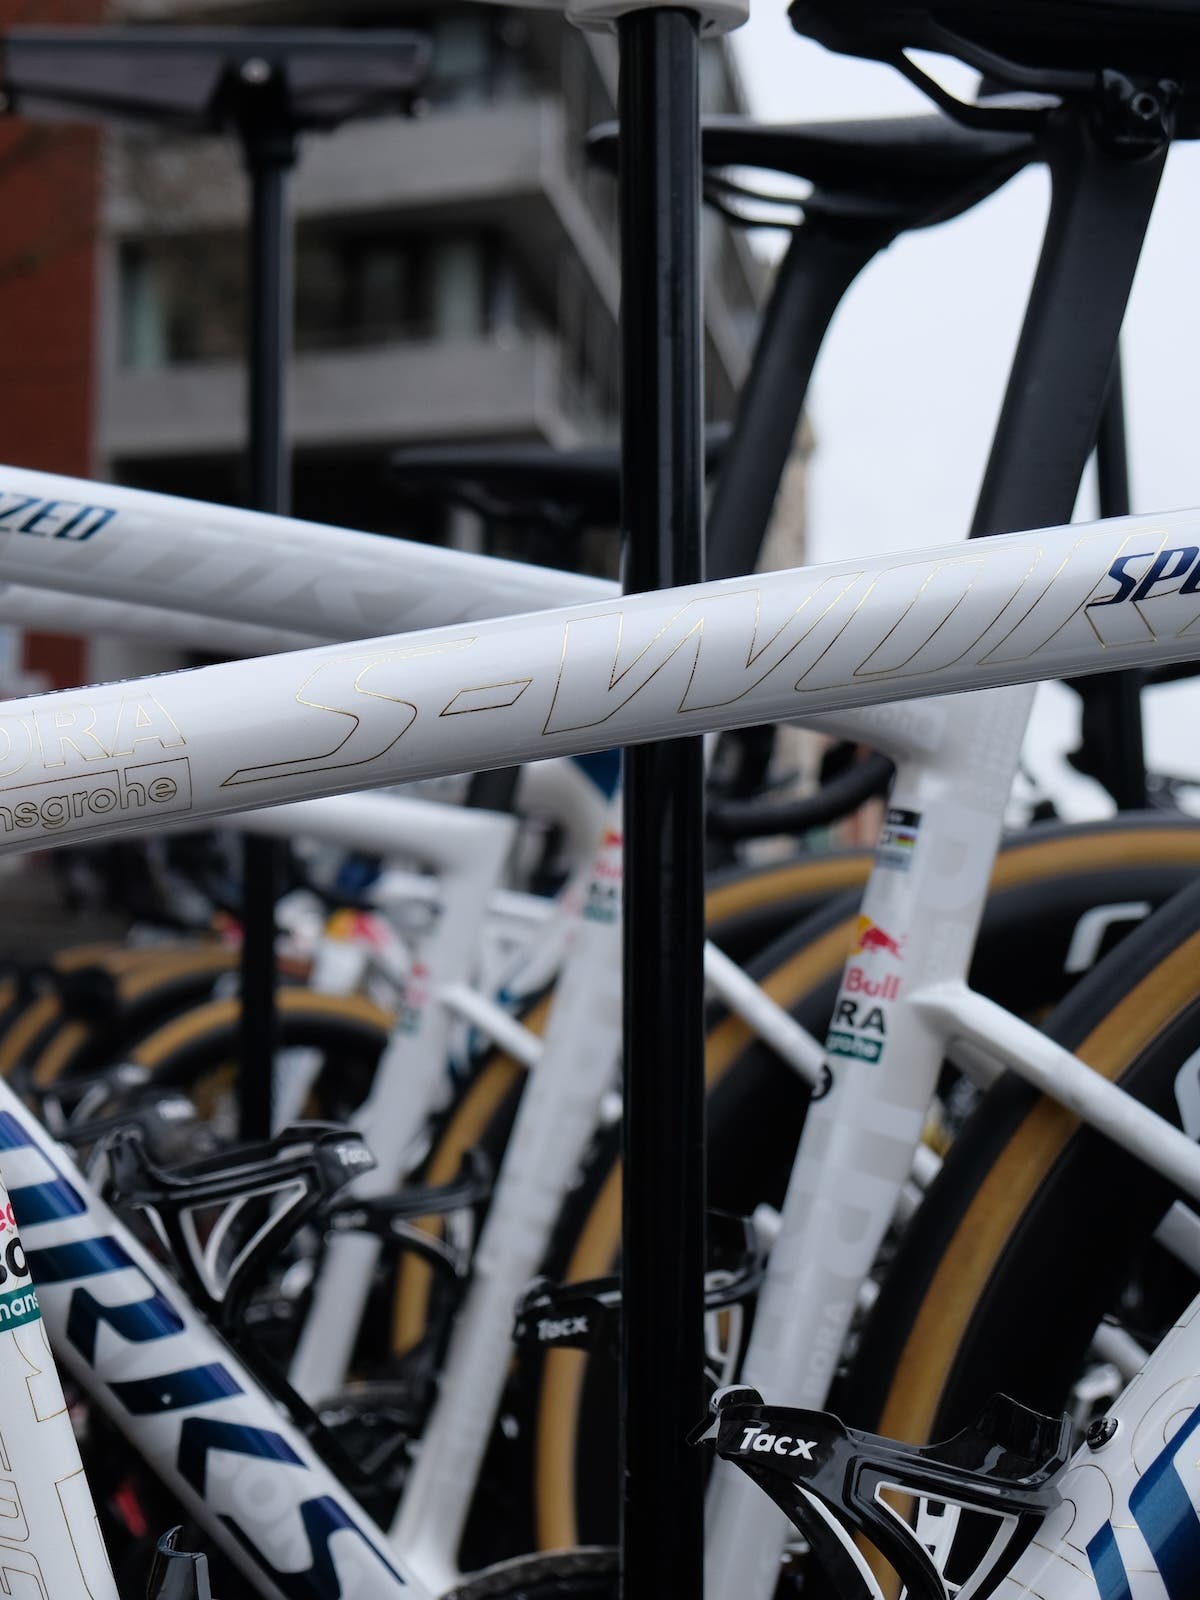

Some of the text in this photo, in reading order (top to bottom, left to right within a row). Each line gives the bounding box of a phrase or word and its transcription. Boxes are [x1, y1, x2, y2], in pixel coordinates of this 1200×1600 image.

[219, 524, 1200, 788] S-WOR
[537, 1316, 590, 1341] Tacx
[739, 1426, 818, 1462] Tacx
